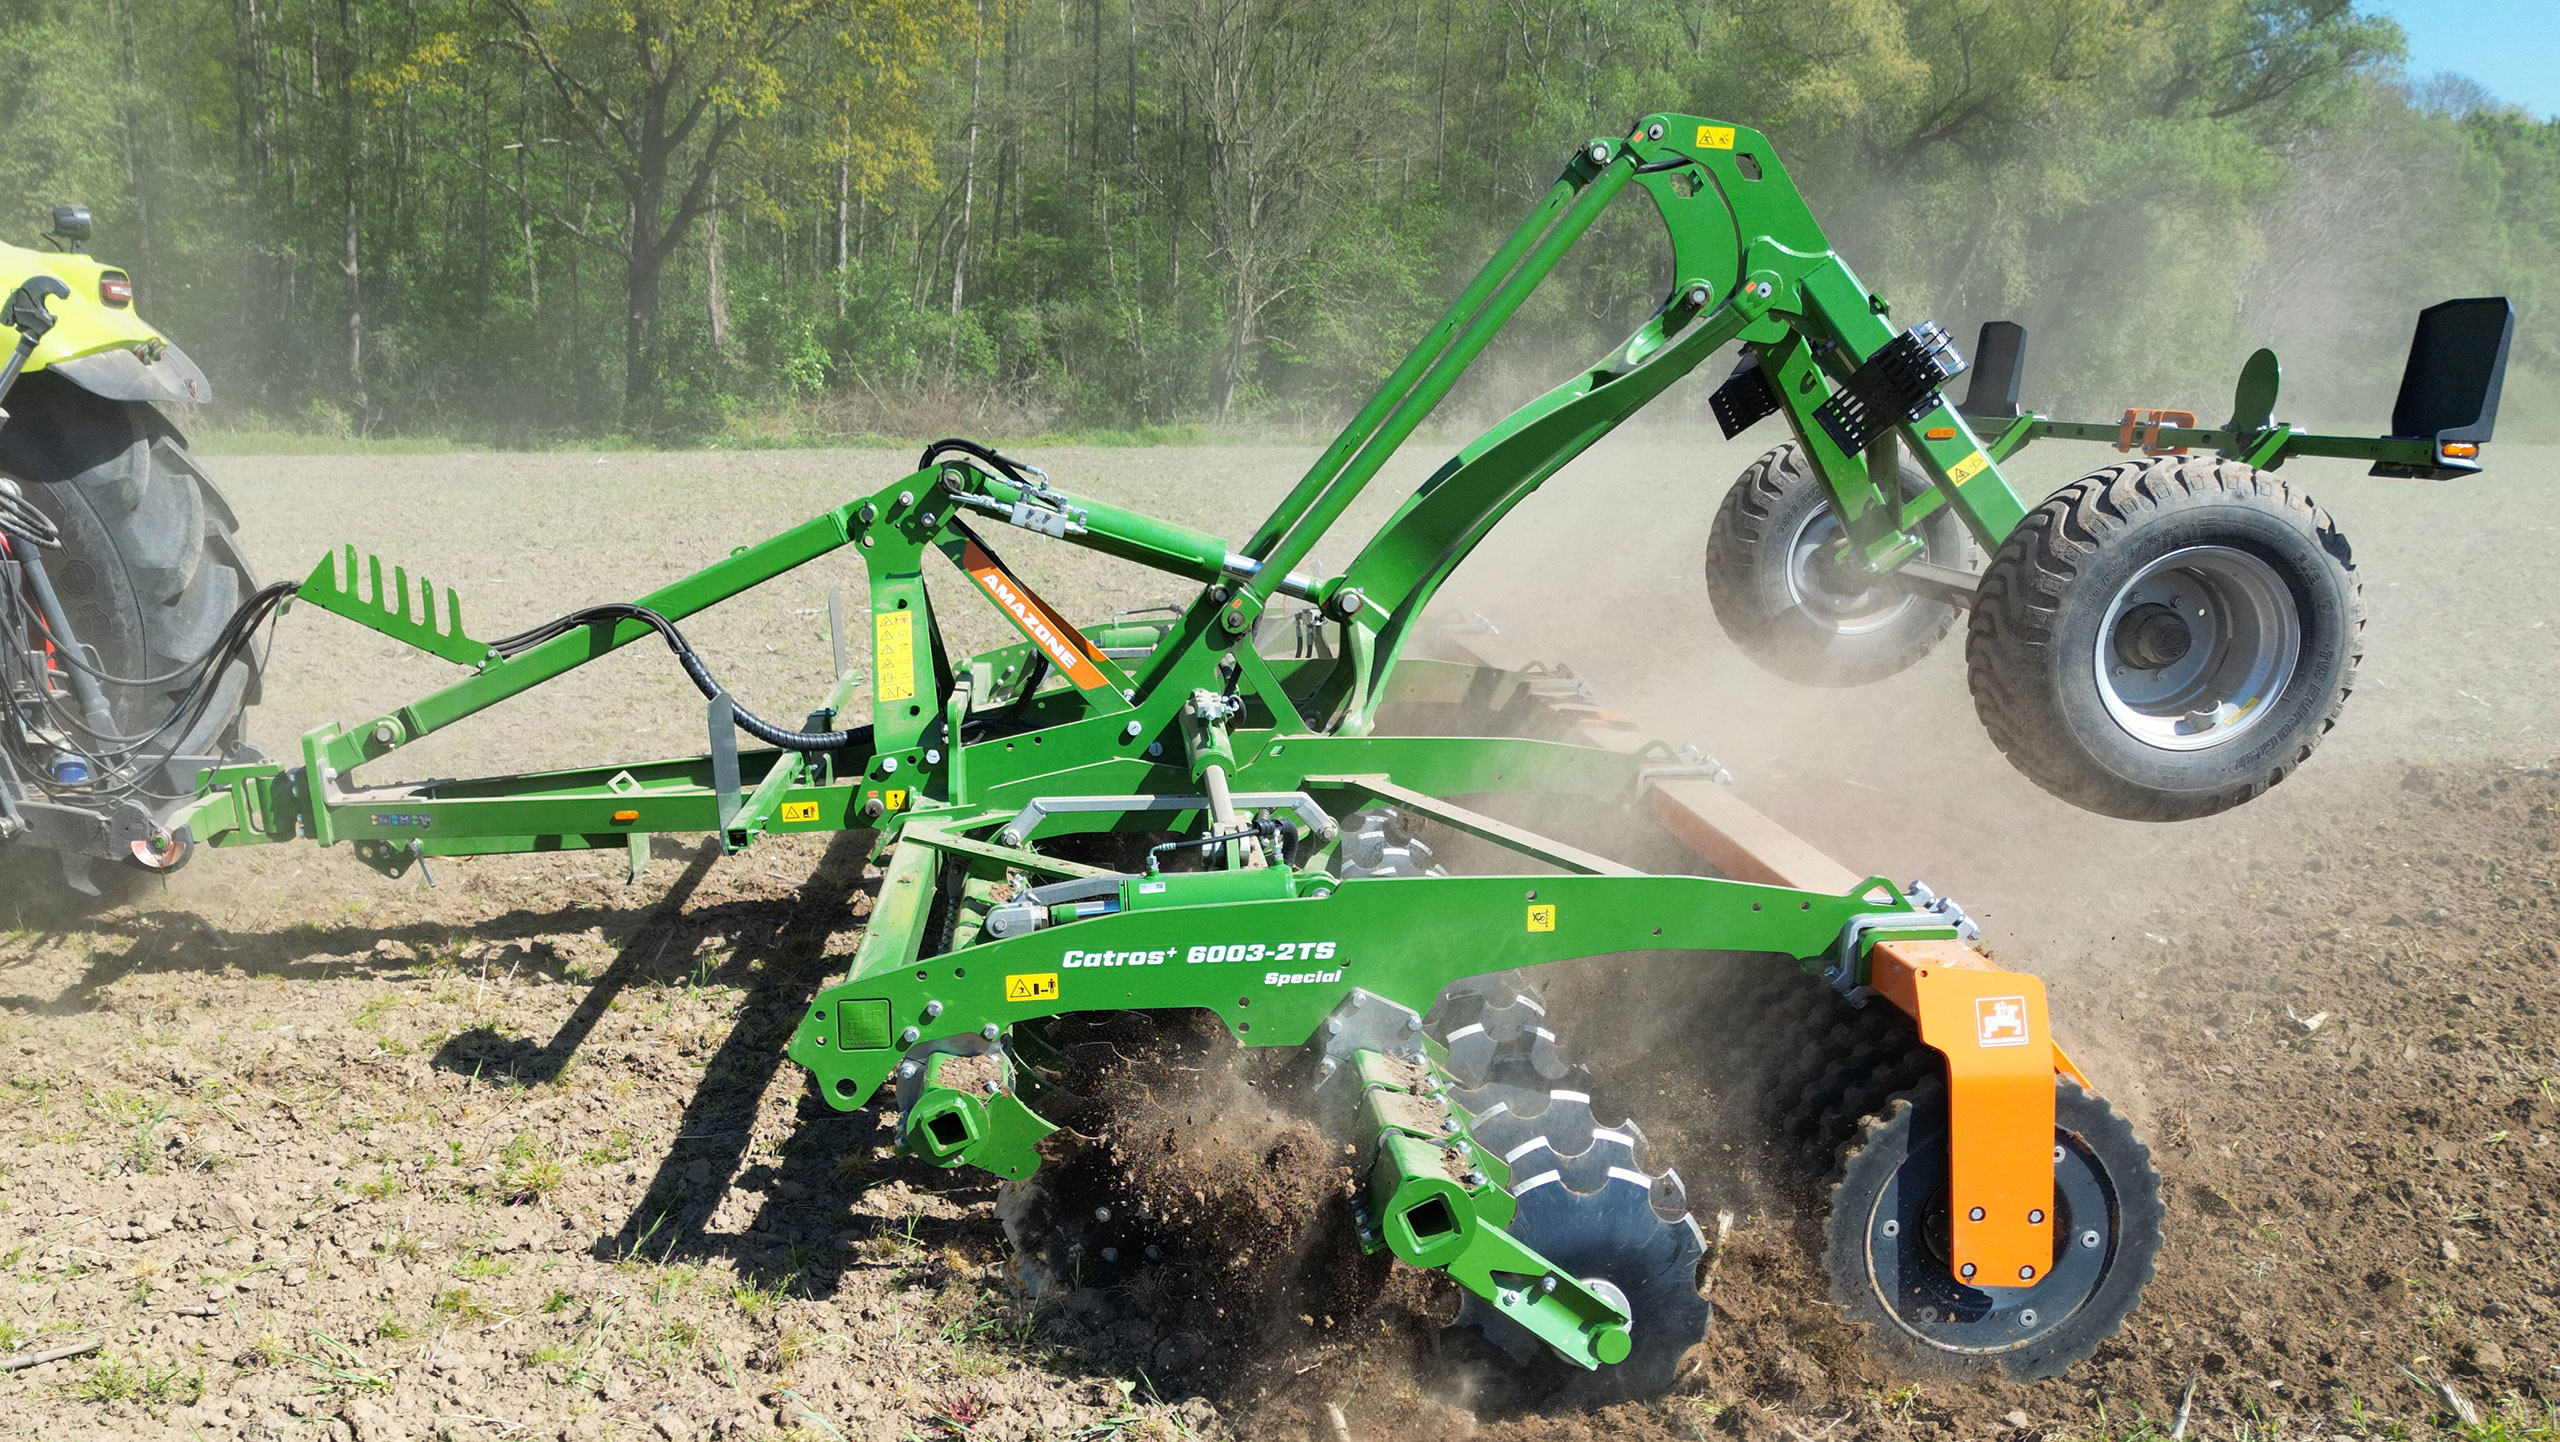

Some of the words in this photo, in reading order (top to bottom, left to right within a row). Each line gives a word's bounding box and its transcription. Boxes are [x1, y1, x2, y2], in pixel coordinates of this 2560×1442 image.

[982, 574, 1078, 669] AMAZONE
[2314, 647, 2334, 681] TVS
[1062, 947, 1178, 968] Catros+
[1186, 941, 1337, 964] 6003-2TS
[1264, 969, 1343, 987] Special
